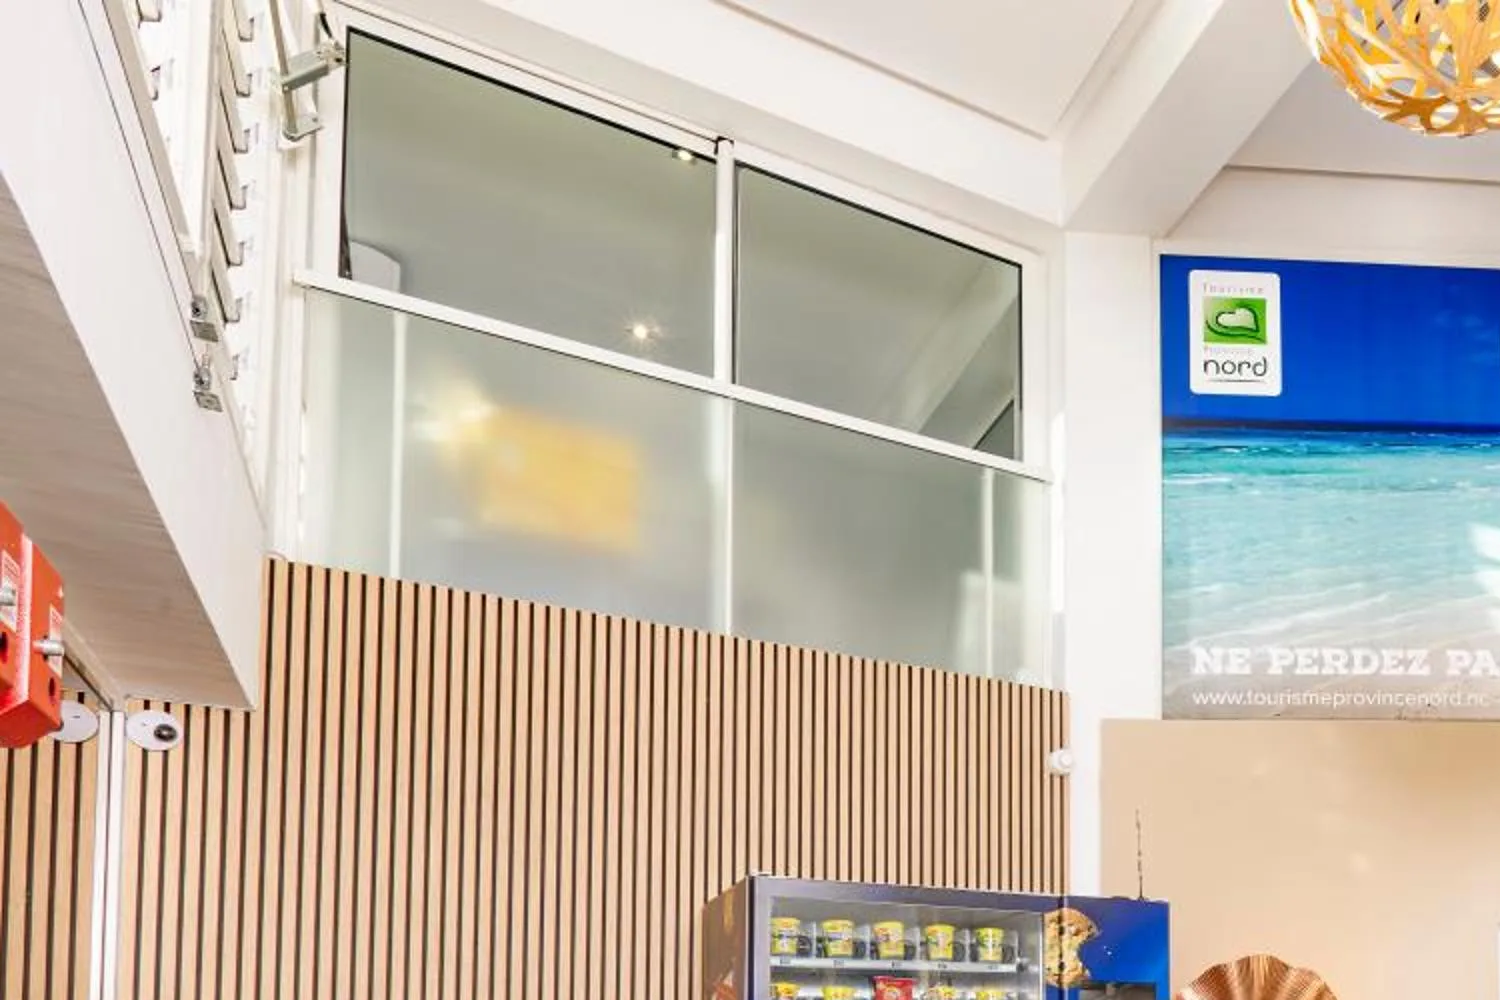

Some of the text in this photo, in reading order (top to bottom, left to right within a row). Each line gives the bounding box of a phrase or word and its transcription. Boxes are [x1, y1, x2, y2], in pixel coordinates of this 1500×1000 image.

[1203, 356, 1267, 377] nord
[1192, 647, 1252, 676] NE
[1266, 647, 1431, 676] PERDEZ
